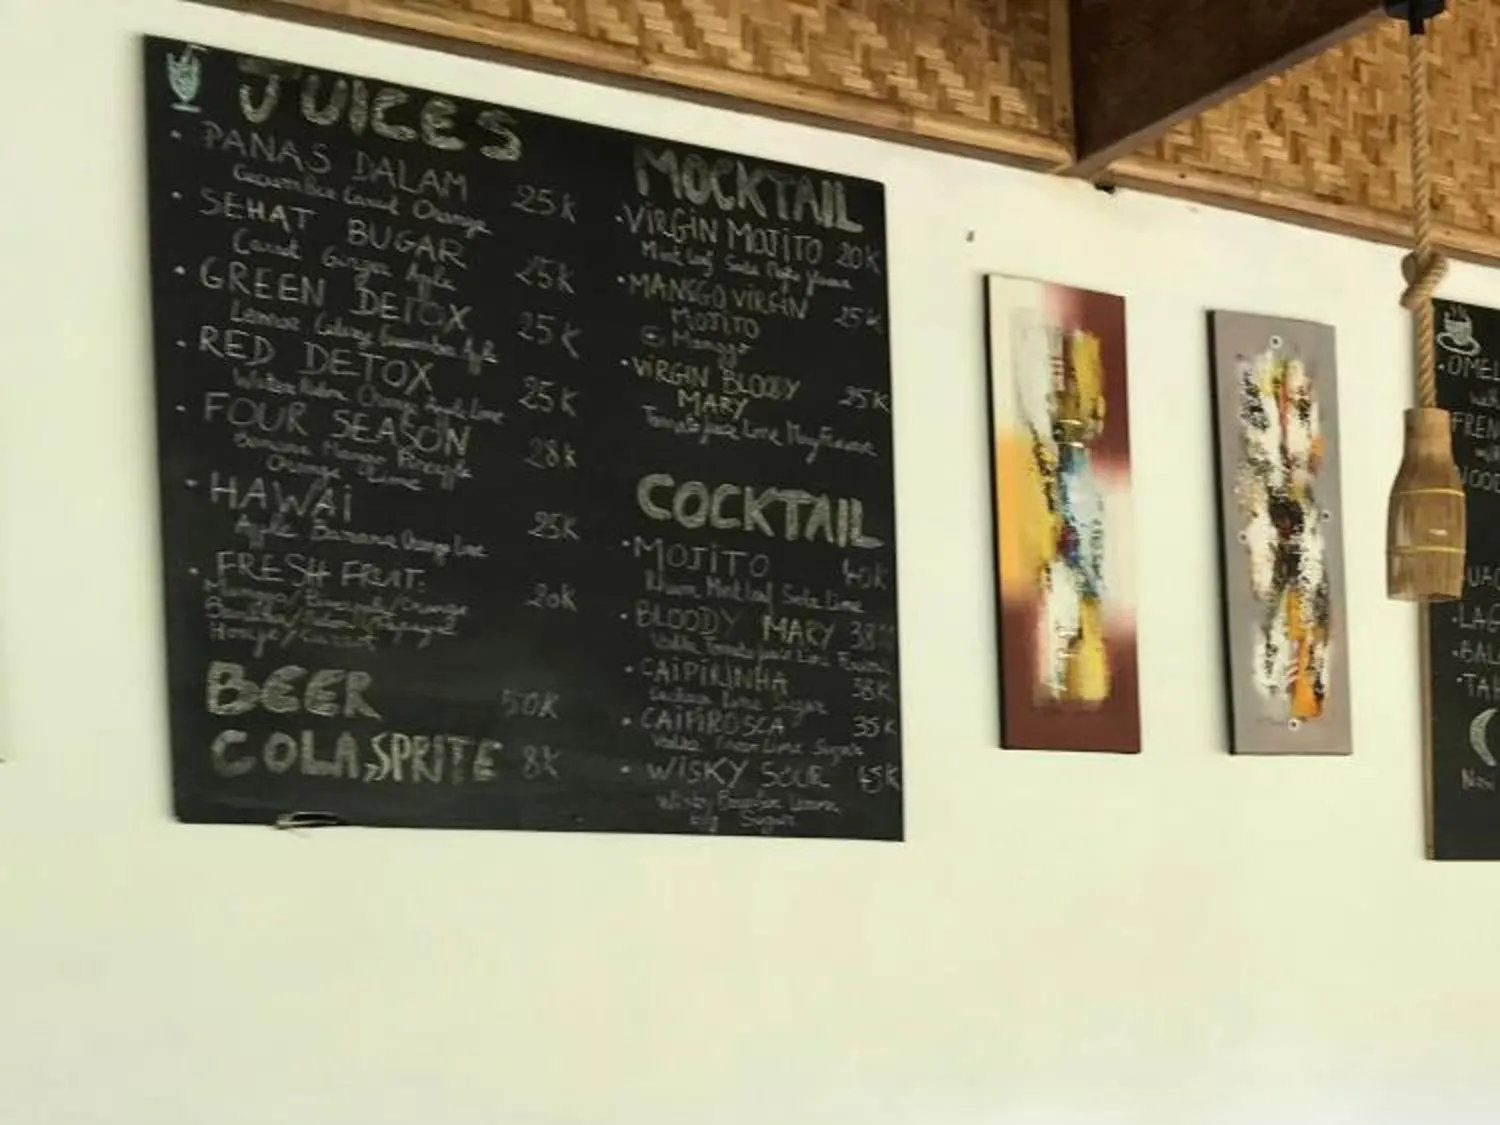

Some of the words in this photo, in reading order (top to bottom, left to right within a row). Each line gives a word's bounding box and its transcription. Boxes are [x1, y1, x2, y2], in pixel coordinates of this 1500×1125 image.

[236, 56, 523, 161] JUICES
[202, 120, 331, 174] PANAS
[351, 150, 468, 203] DALAM
[511, 184, 577, 224] 25K
[633, 144, 865, 234] MOCKTAIL
[200, 186, 318, 234] SEHAT
[349, 217, 468, 271] BUGAR
[515, 255, 576, 295] 25K
[835, 241, 882, 276] 20K
[201, 256, 327, 308] GREEN
[349, 286, 473, 334] DETOX
[517, 311, 584, 361] 25K
[199, 325, 276, 368] RED
[297, 341, 435, 396] DETOX
[203, 391, 310, 437] FOUR
[677, 388, 750, 420] MARY
[636, 472, 886, 549] COCKTAIL
[215, 550, 332, 588] FRESH
[636, 598, 745, 638] BLOODY
[205, 660, 384, 721] BEER
[367, 732, 504, 785] SPRITE
